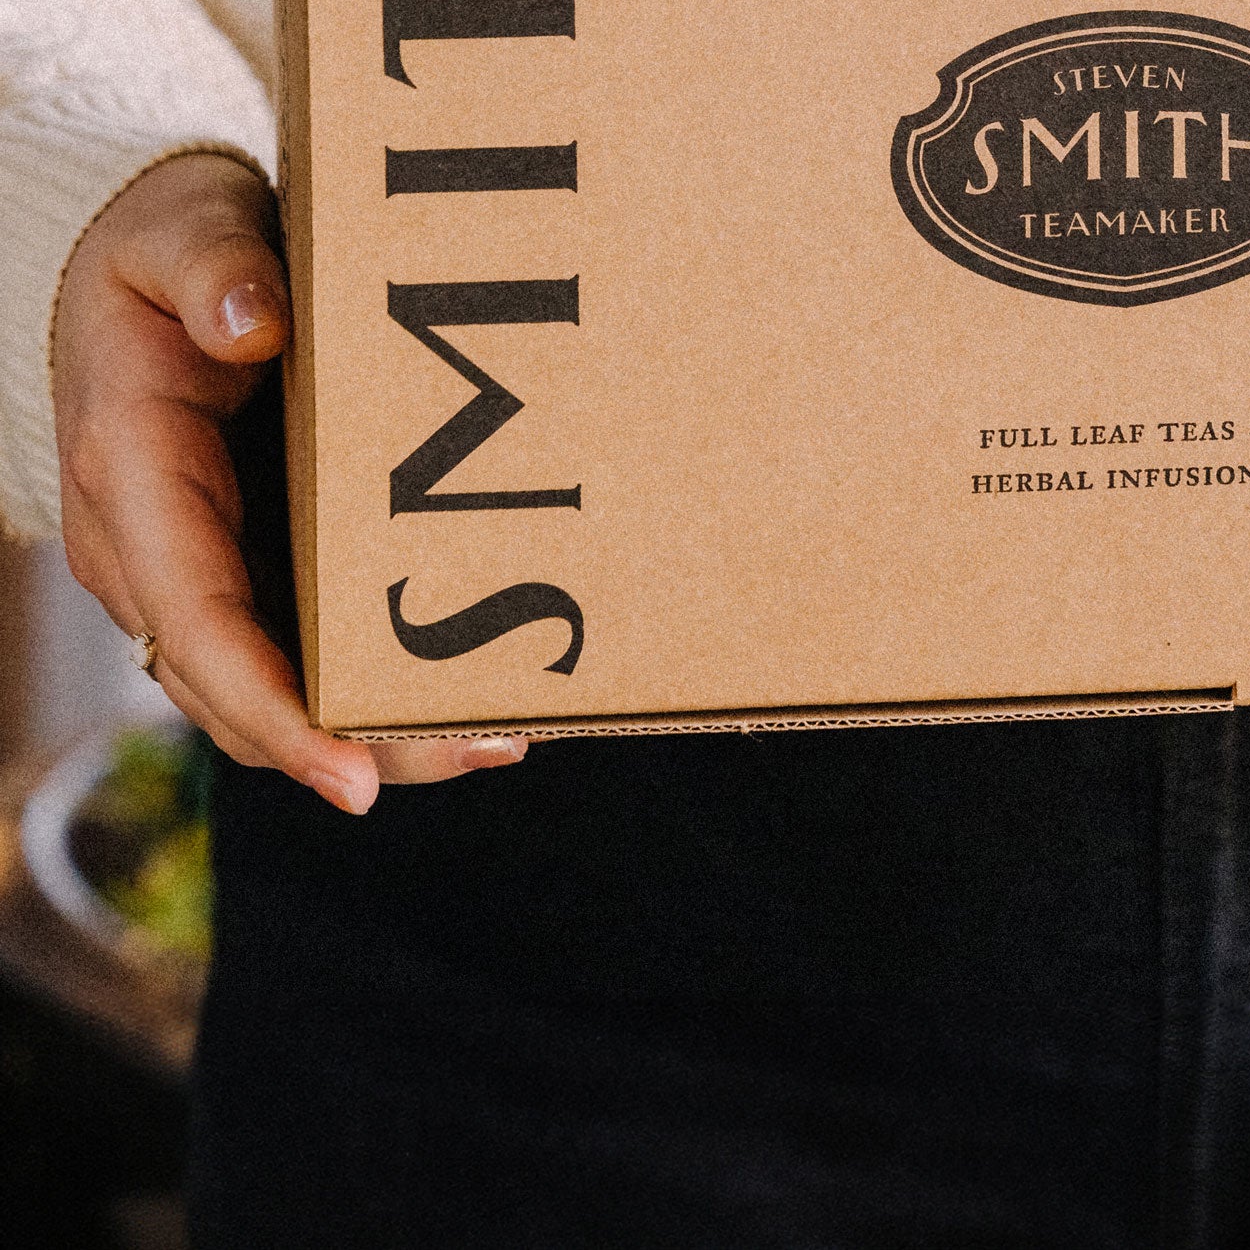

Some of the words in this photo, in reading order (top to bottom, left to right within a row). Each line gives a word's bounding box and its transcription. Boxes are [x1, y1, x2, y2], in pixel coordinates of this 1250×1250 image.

[1054, 66, 1182, 93] STEVEN
[1020, 209, 1228, 237] TEAMAKER
[980, 428, 1057, 449] FULL
[1071, 424, 1144, 446] LEAF
[1158, 421, 1234, 442] TEAS
[972, 471, 1093, 494] HERBAL
